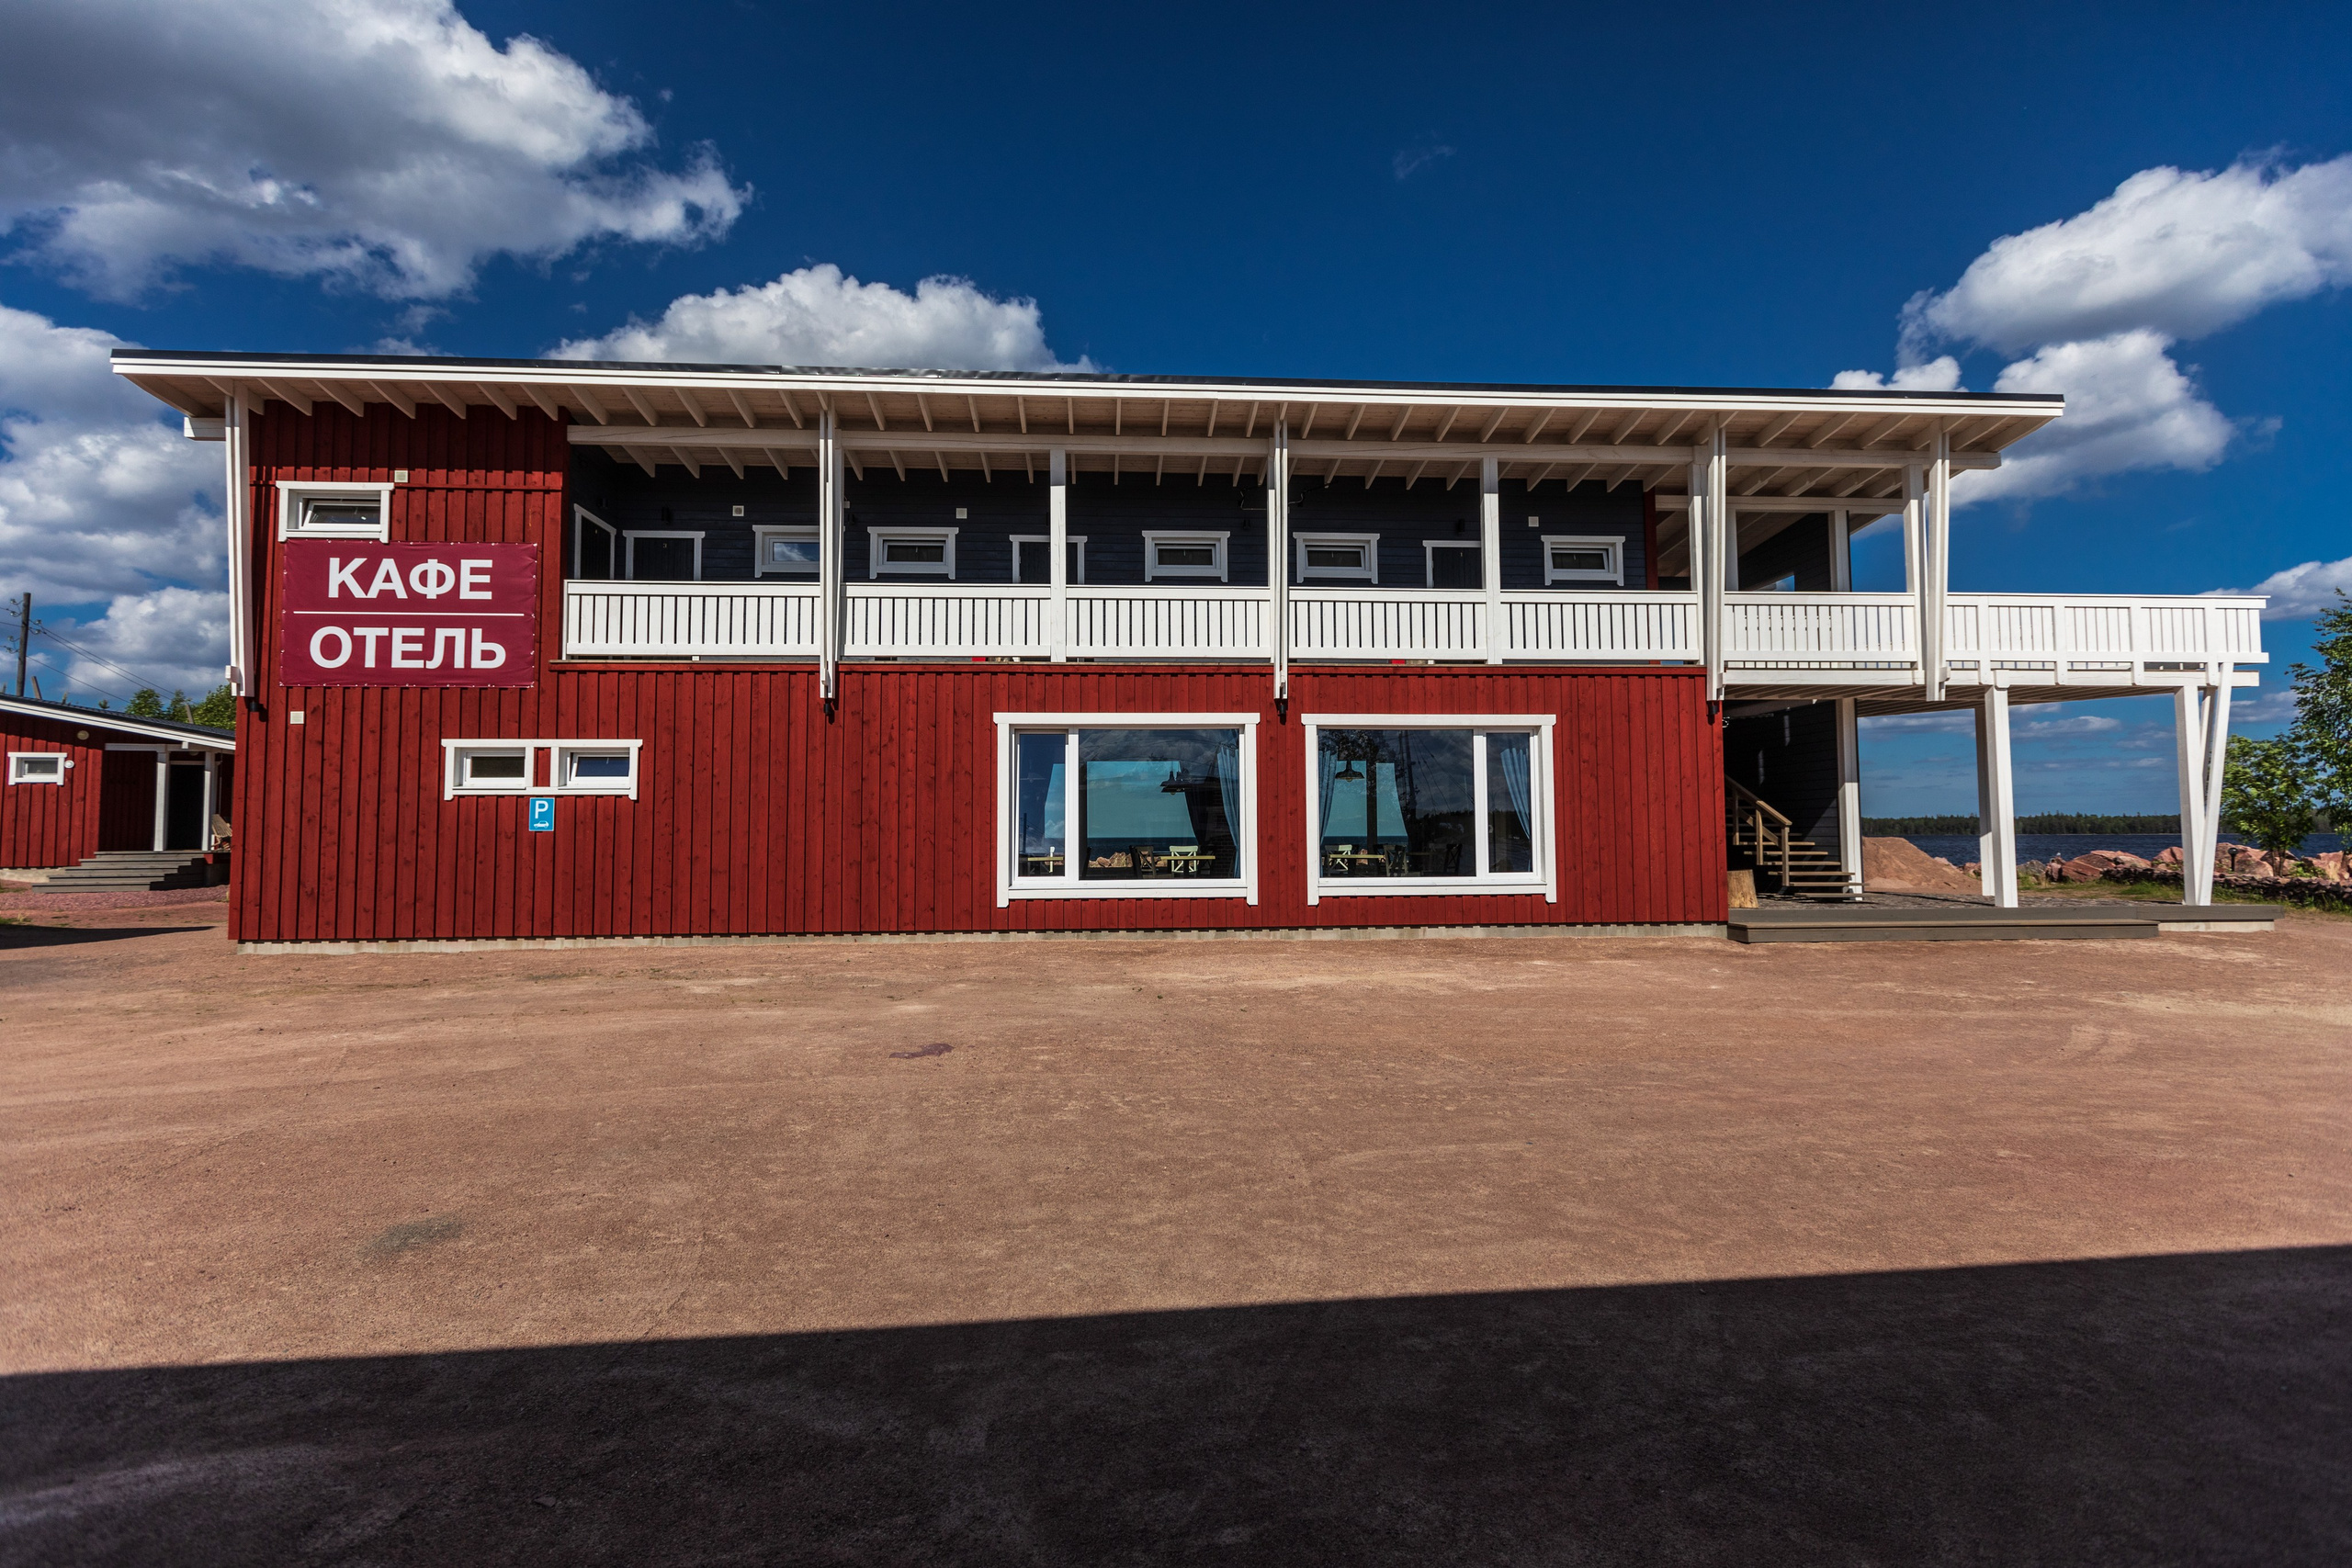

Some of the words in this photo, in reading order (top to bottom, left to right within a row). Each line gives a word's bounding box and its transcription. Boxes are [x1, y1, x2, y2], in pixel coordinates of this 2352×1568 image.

[328, 557, 493, 600] КАФЕ
[310, 626, 506, 669] ОТЕЛЬ
[535, 800, 549, 819] P
